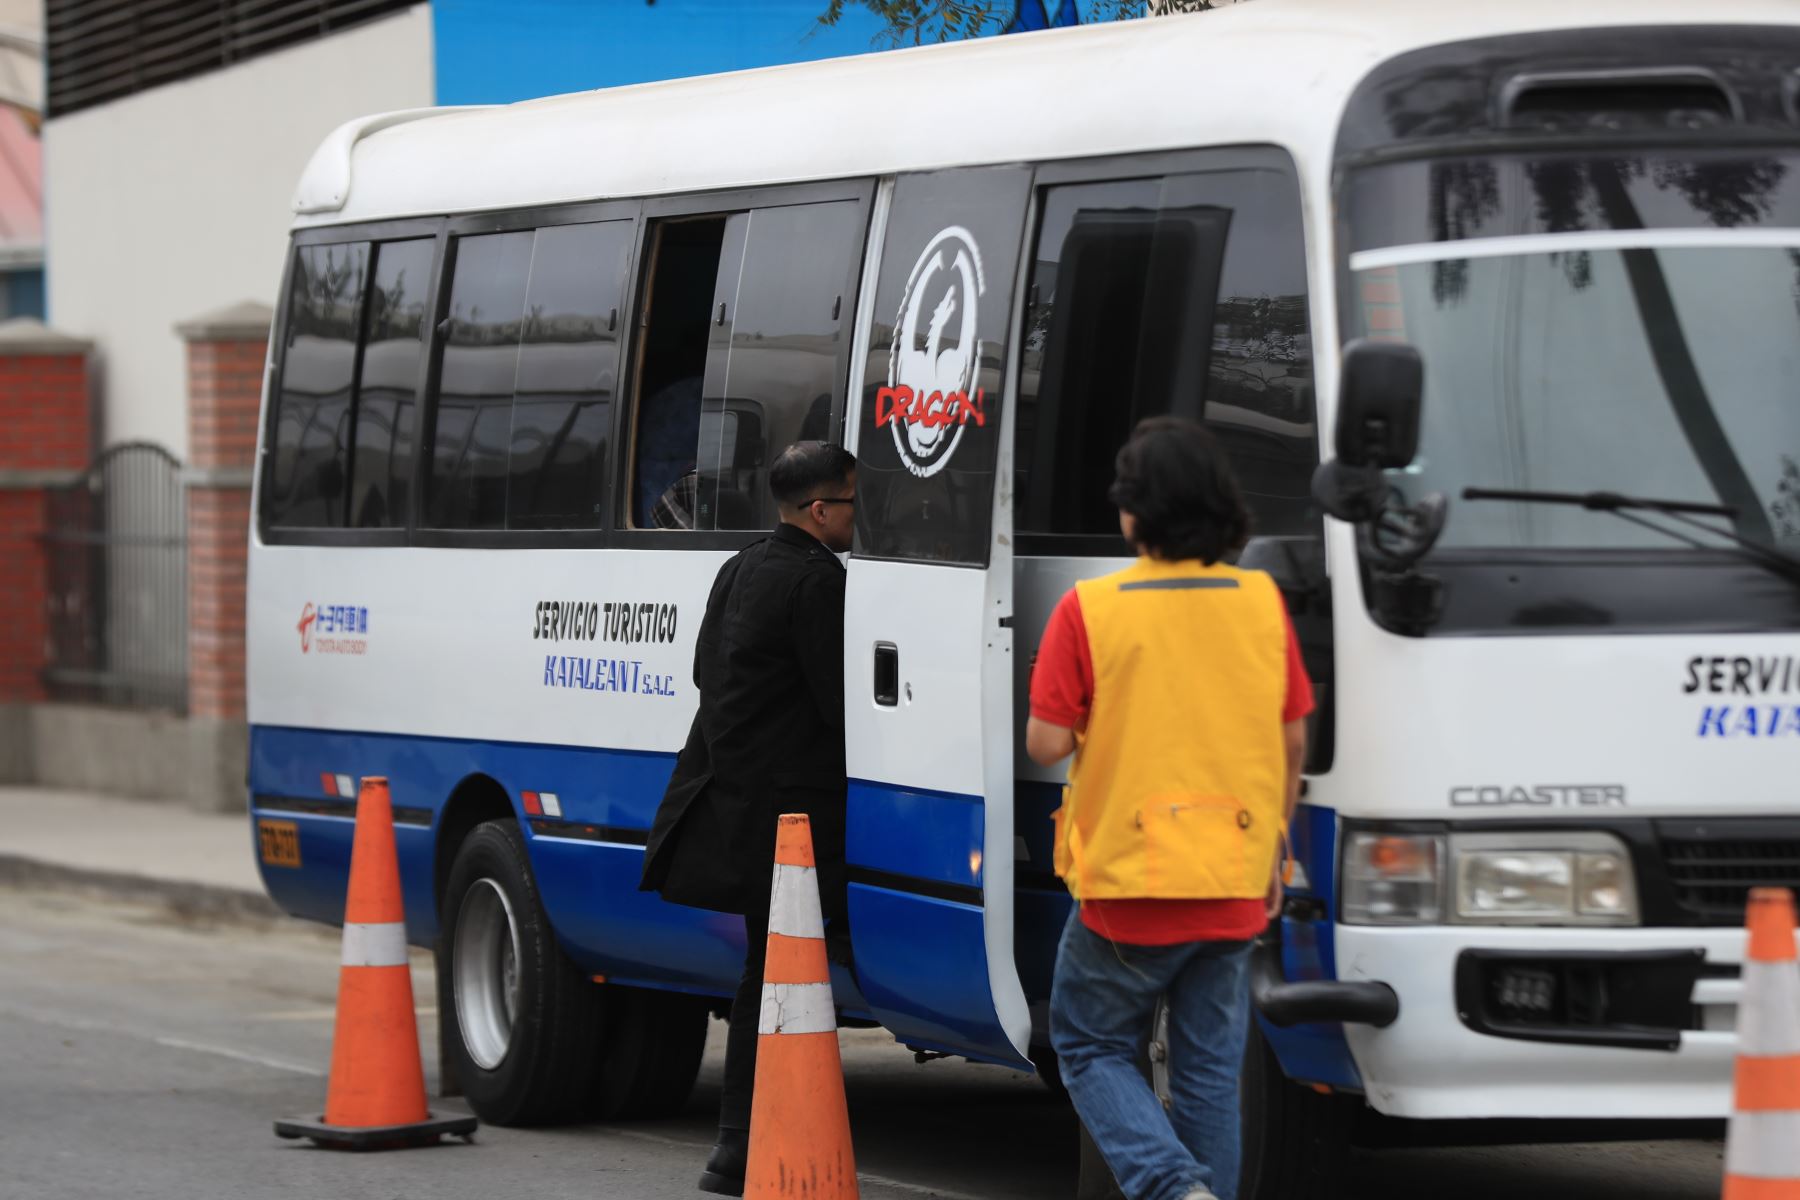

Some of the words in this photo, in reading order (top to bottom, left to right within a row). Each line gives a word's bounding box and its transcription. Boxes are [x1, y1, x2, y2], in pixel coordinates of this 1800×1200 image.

[875, 385, 985, 431] DRAGON
[533, 600, 598, 642] SERVICIO
[603, 602, 678, 645] TURISTICO
[543, 654, 643, 694] KATALEANT
[641, 674, 676, 697] S.A.C.
[1682, 656, 1800, 695] SERVI
[1450, 784, 1627, 807] COASTER
